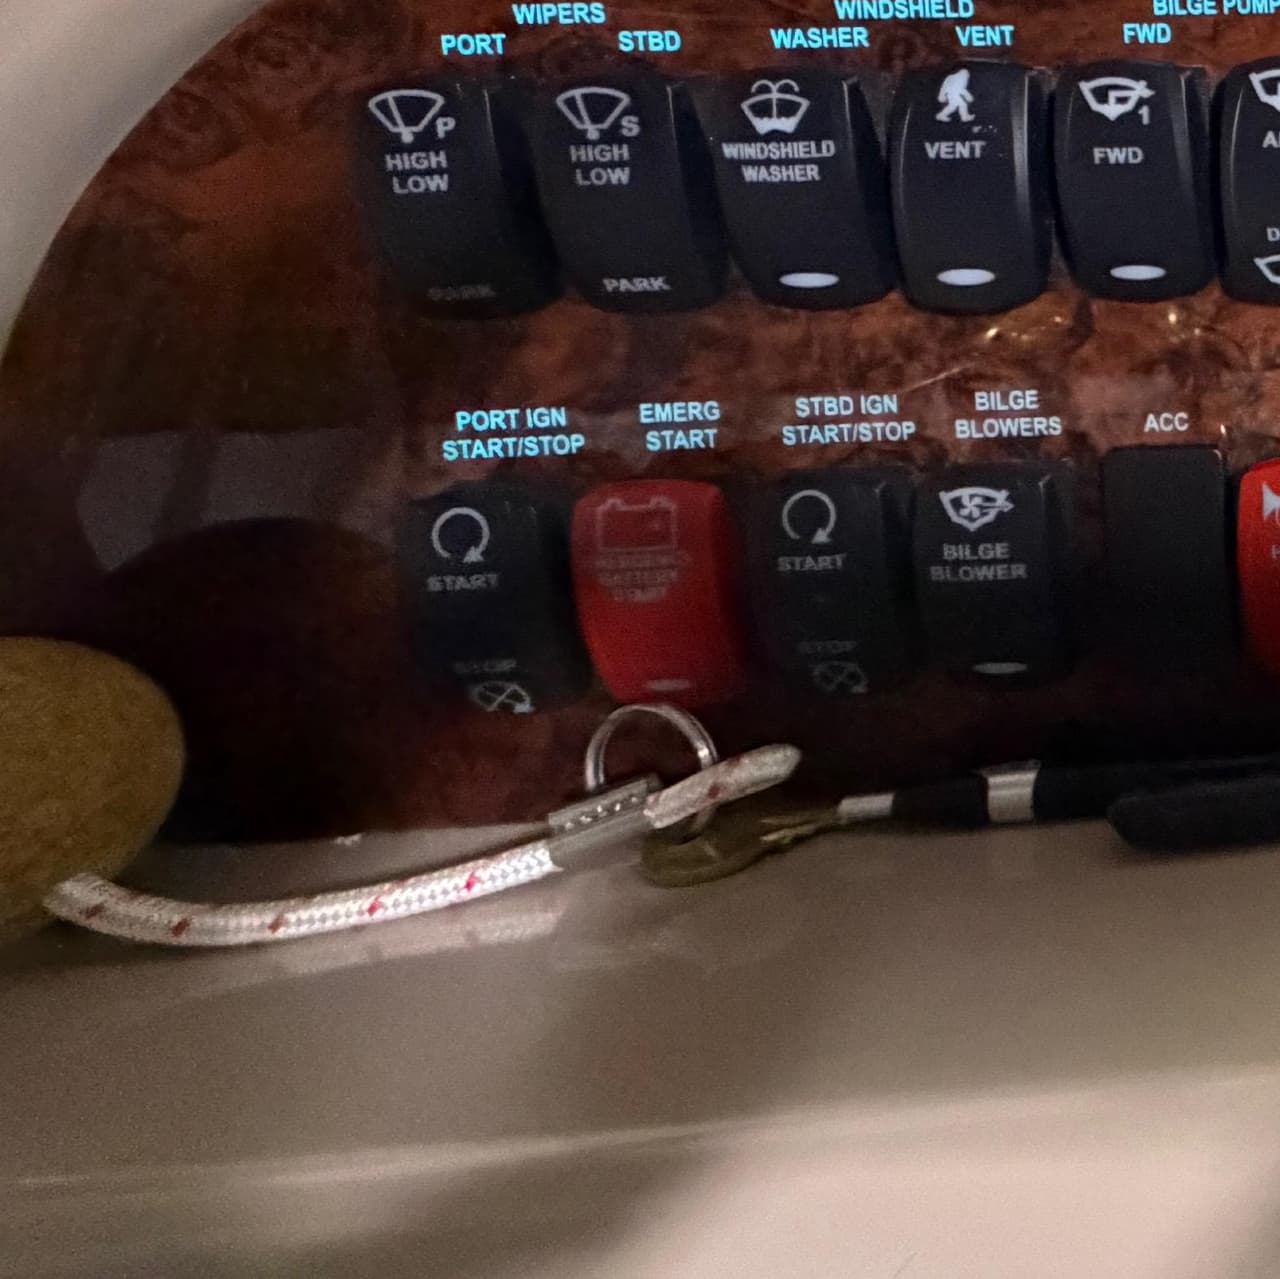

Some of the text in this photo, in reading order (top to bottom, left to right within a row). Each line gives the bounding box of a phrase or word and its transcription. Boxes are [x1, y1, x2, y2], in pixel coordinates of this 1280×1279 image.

[512, 2, 606, 25] WIPERS
[618, 31, 681, 53] STBD
[770, 27, 870, 49] WASHER
[955, 25, 1014, 47] VENT
[1123, 22, 1172, 44] FWD
[441, 34, 506, 55] PORT
[435, 117, 456, 138] P
[621, 116, 640, 137] S
[570, 144, 630, 163] HIGH
[722, 141, 836, 160] WINDSHIELD
[924, 140, 986, 160] VENT
[1093, 147, 1144, 165] FWD
[385, 151, 448, 171] HIGH
[575, 167, 630, 186] LOW
[741, 164, 821, 182] WASHER
[392, 174, 449, 194] LOW
[602, 276, 671, 293] PARK
[795, 395, 898, 418] STBD IGN
[974, 390, 1039, 411] BILGE
[455, 407, 567, 432] PORT IGN
[639, 401, 721, 423] EMERG
[782, 421, 916, 446] START/STOP
[954, 416, 1062, 440] BLOWERS
[1144, 413, 1190, 433] ACC
[442, 434, 585, 461] START/STOP
[645, 429, 718, 452] START
[942, 543, 1010, 561] BILGE
[777, 554, 847, 573] START
[930, 563, 1027, 582] BLOWER
[426, 573, 499, 592] START
